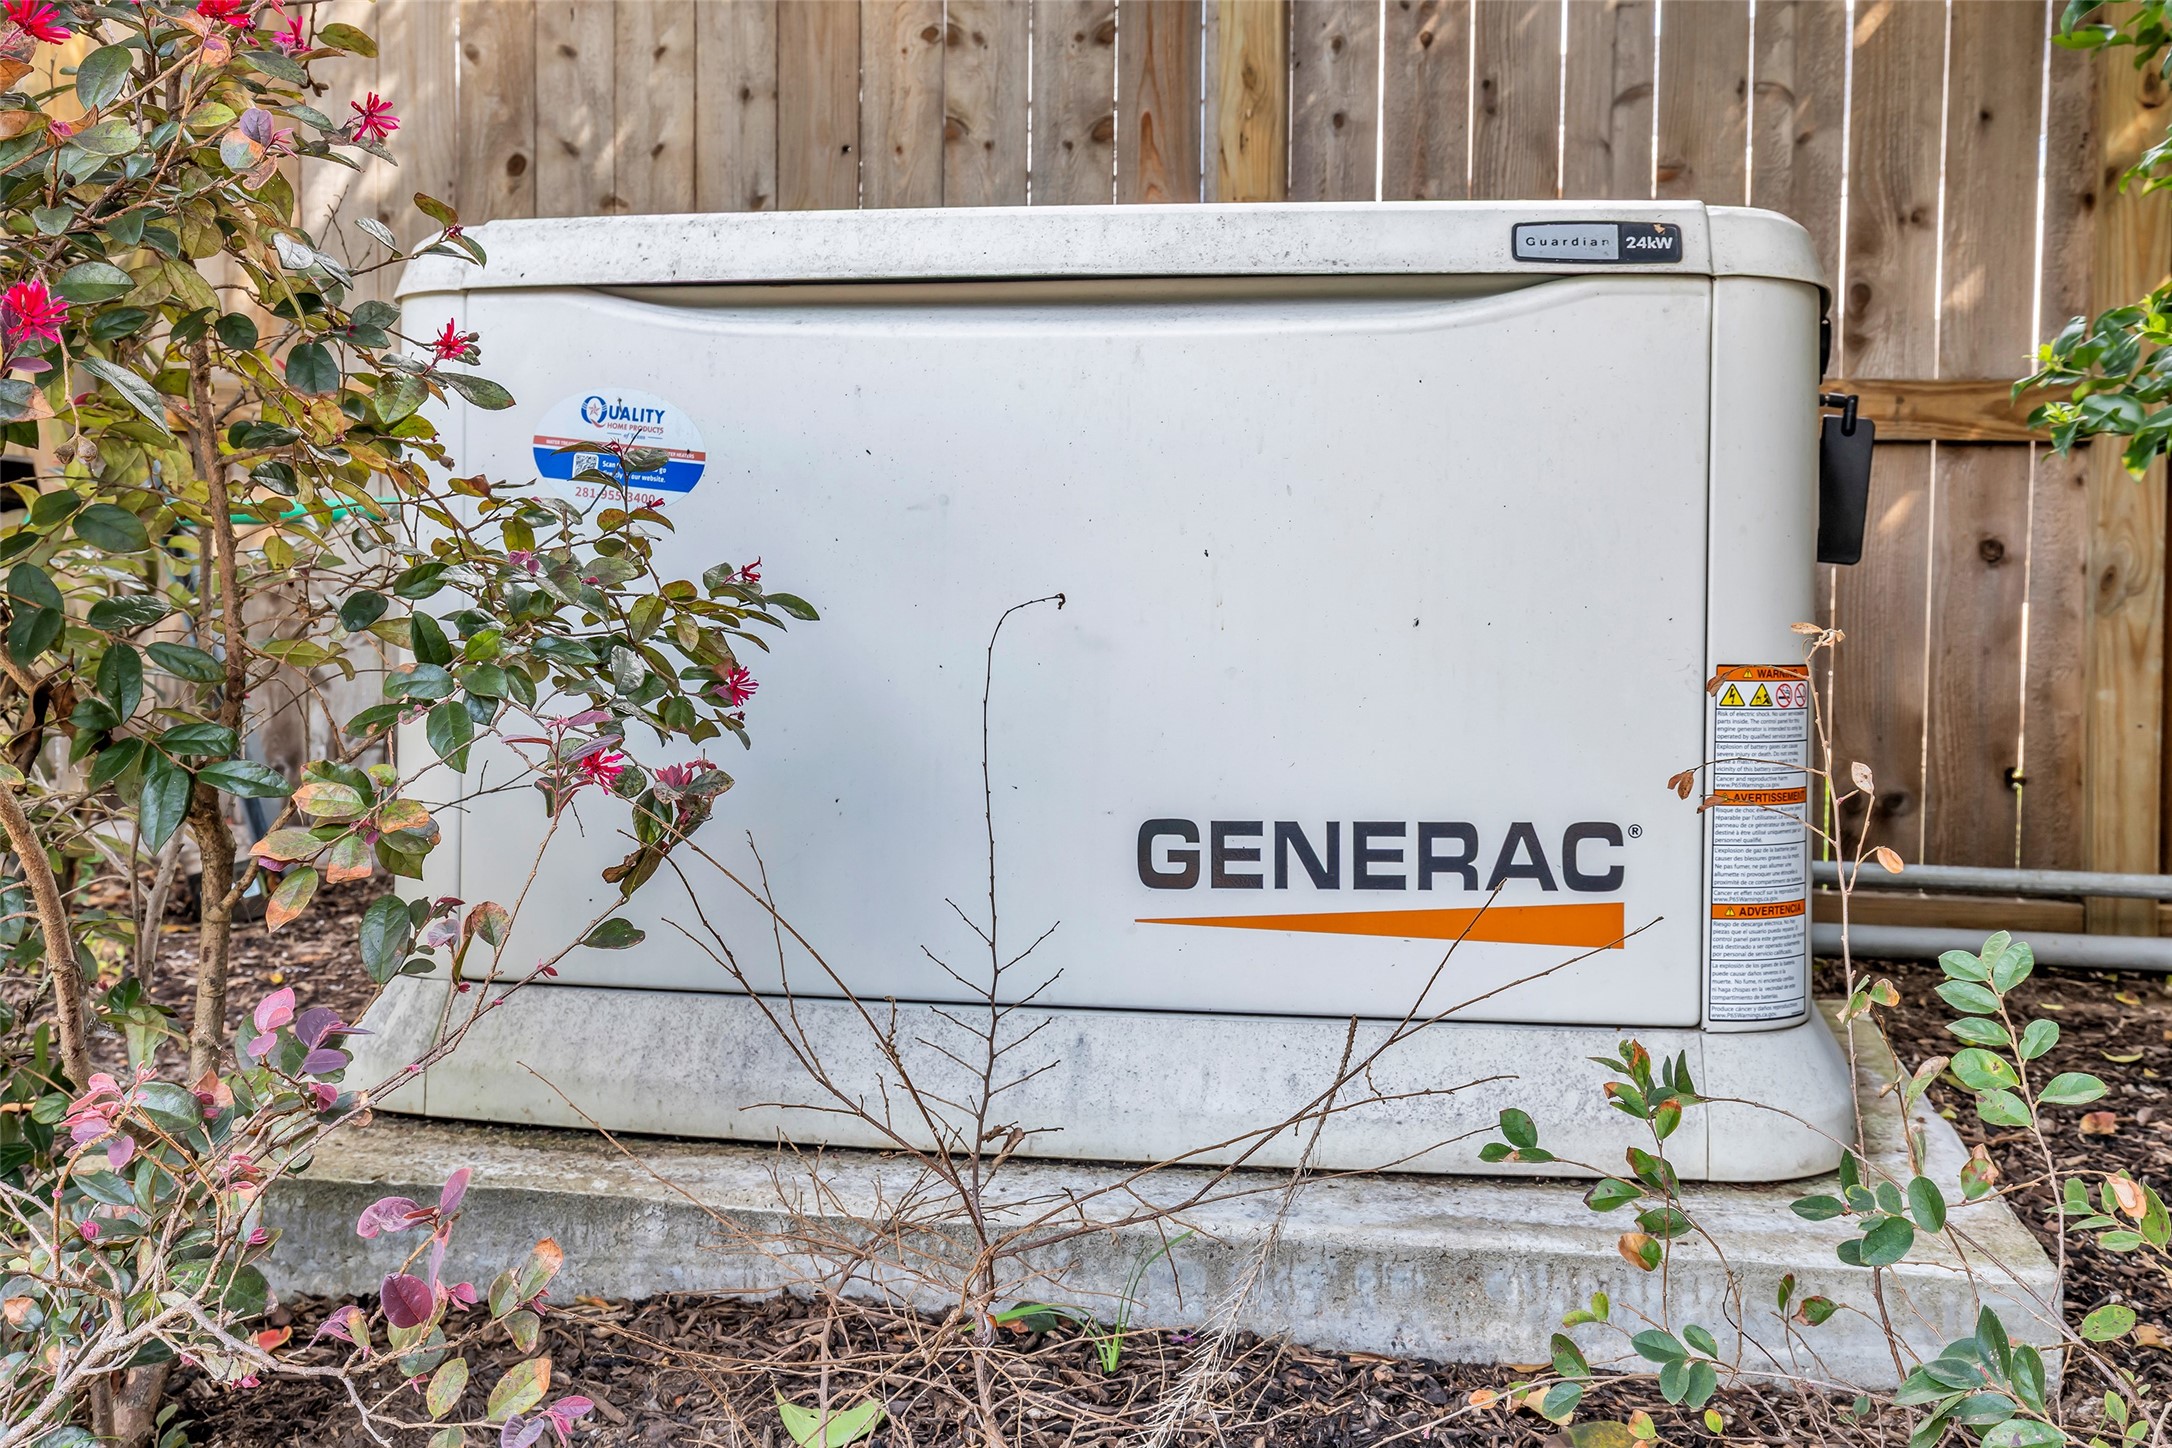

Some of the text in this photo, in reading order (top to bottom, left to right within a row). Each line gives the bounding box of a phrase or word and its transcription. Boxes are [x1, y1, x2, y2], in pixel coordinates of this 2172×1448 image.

[1525, 236, 1673, 249] Guardian 24kW
[581, 395, 665, 428] QUALITY
[607, 422, 664, 434] HOME PRODUCTS
[602, 460, 615, 468] Scan
[659, 467, 667, 475] go
[641, 475, 666, 483] website.
[1732, 791, 1805, 803] AVERTISSEMENT
[1136, 818, 1625, 892] GENERAC
[1739, 904, 1801, 916] ADVERTENCIA
